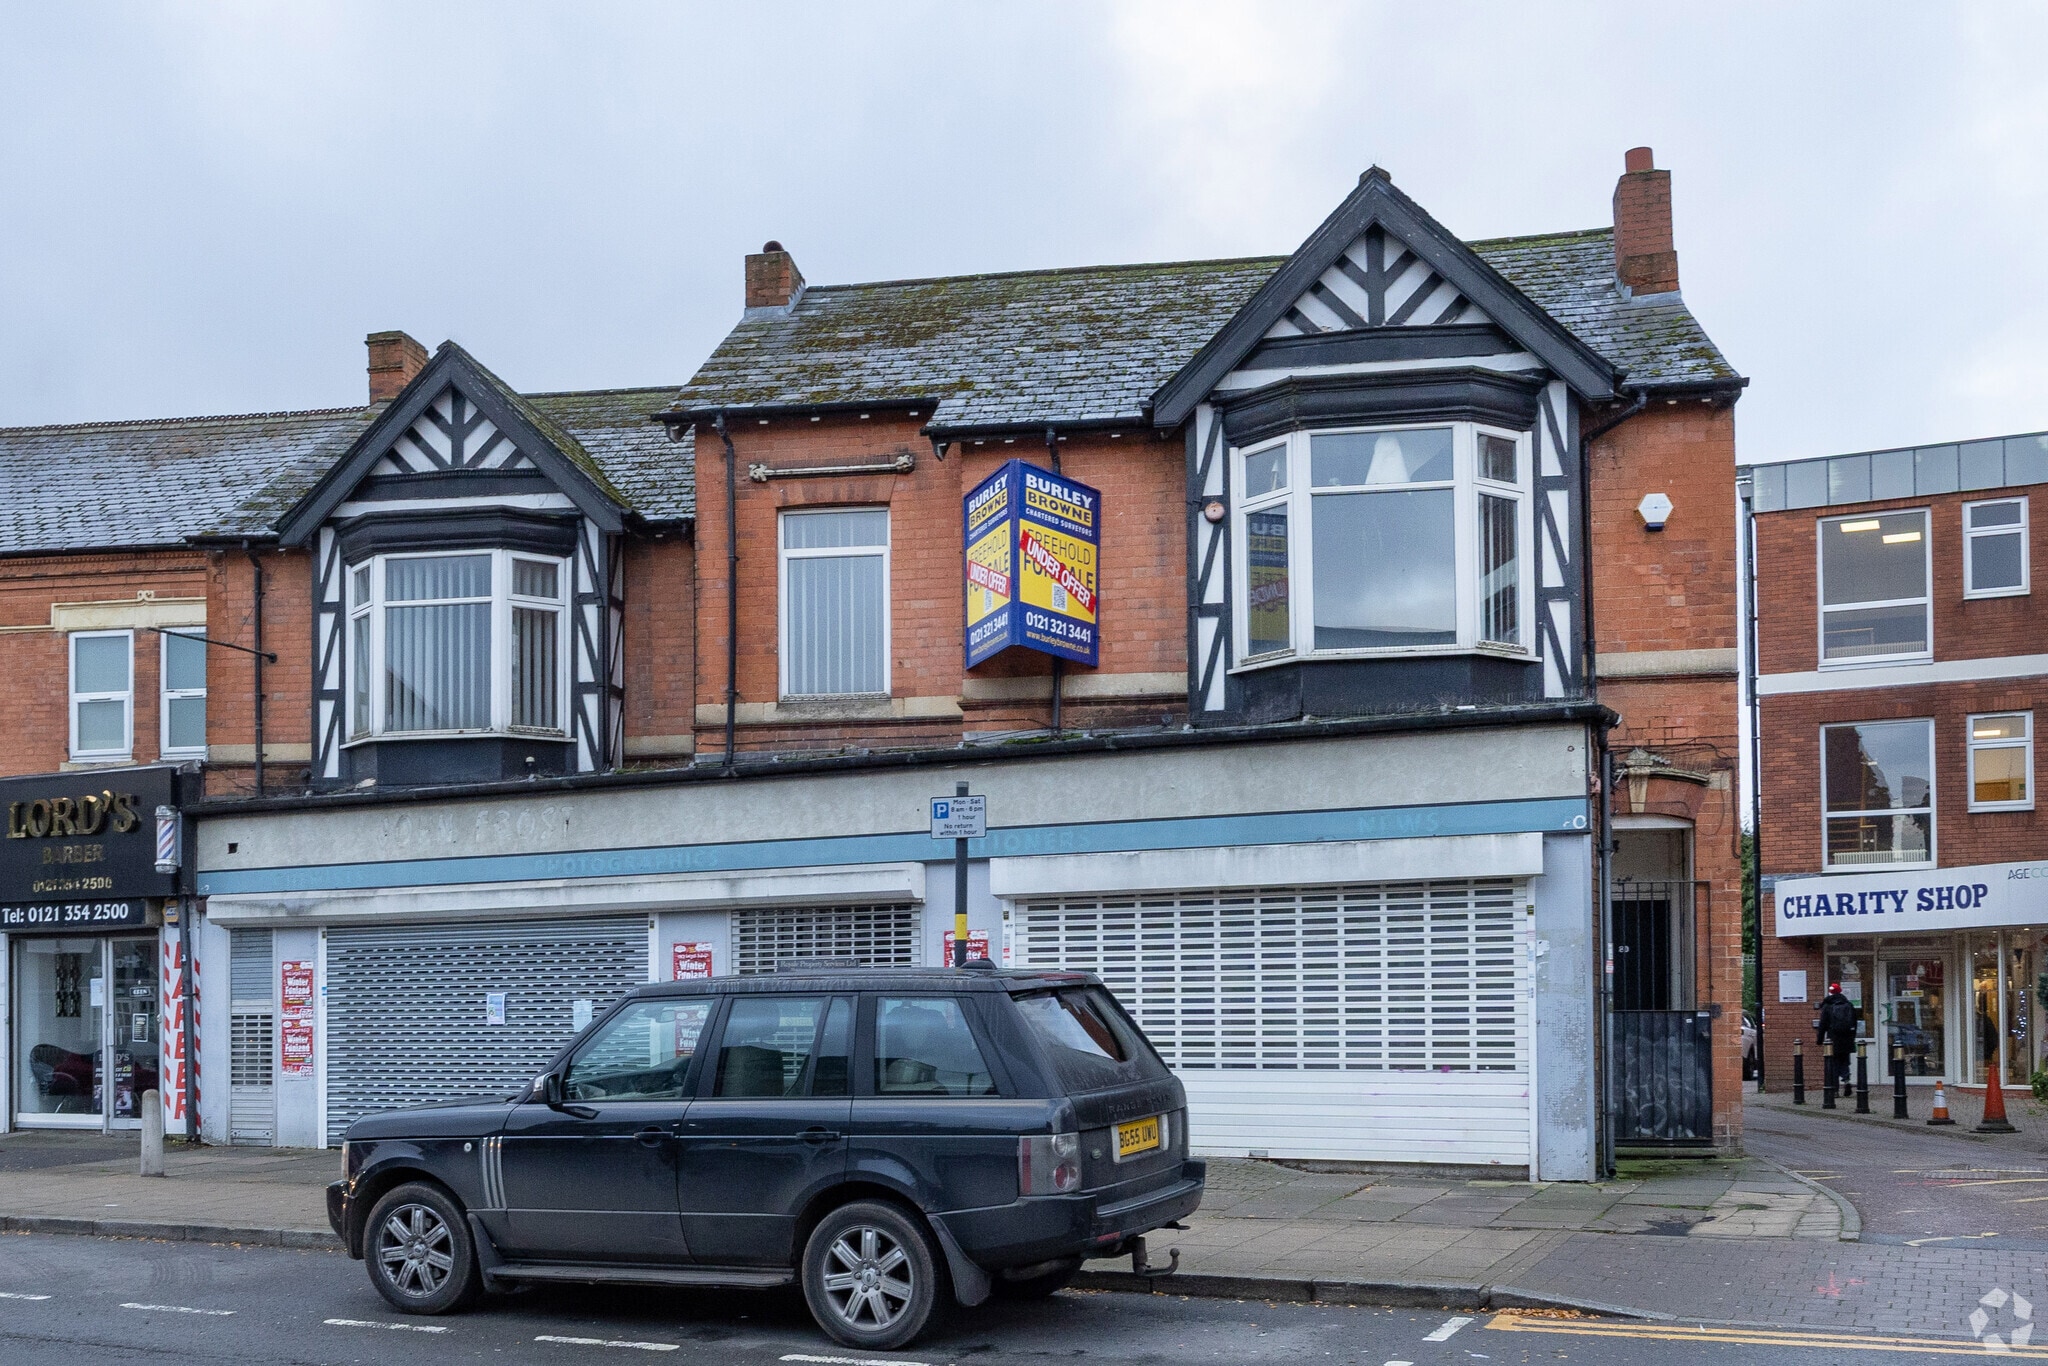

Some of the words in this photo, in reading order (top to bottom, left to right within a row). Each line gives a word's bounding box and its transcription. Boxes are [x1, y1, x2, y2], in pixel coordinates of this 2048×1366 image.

[969, 474, 1008, 513] BURLEY
[1026, 473, 1092, 508] BURLEY
[970, 491, 1006, 527] BROWNE
[1026, 508, 1059, 524] CHARTERED
[1060, 520, 1092, 536] SURVEYORS
[1028, 491, 1091, 523] BROWNE
[970, 562, 989, 586] UNDER
[989, 570, 1007, 594] OFFER
[1026, 537, 1060, 579] UNDER
[1061, 569, 1091, 608] OFFER
[1026, 611, 1048, 630] 0121
[1050, 618, 1066, 636] 321
[1068, 624, 1091, 643] 3441
[1026, 631, 1090, 655] www.burleybrowne.co.uk
[6, 789, 138, 839] LORD'S
[937, 804, 947, 818] P
[2, 908, 24, 923] Tel:
[28, 906, 60, 922] 0121
[65, 905, 91, 921] 354
[94, 903, 129, 920] 2500
[1783, 889, 1909, 919] CHARITY
[1916, 883, 1988, 912] SHOP
[679, 959, 707, 971] Winter
[1119, 1127, 1140, 1148] BG55
